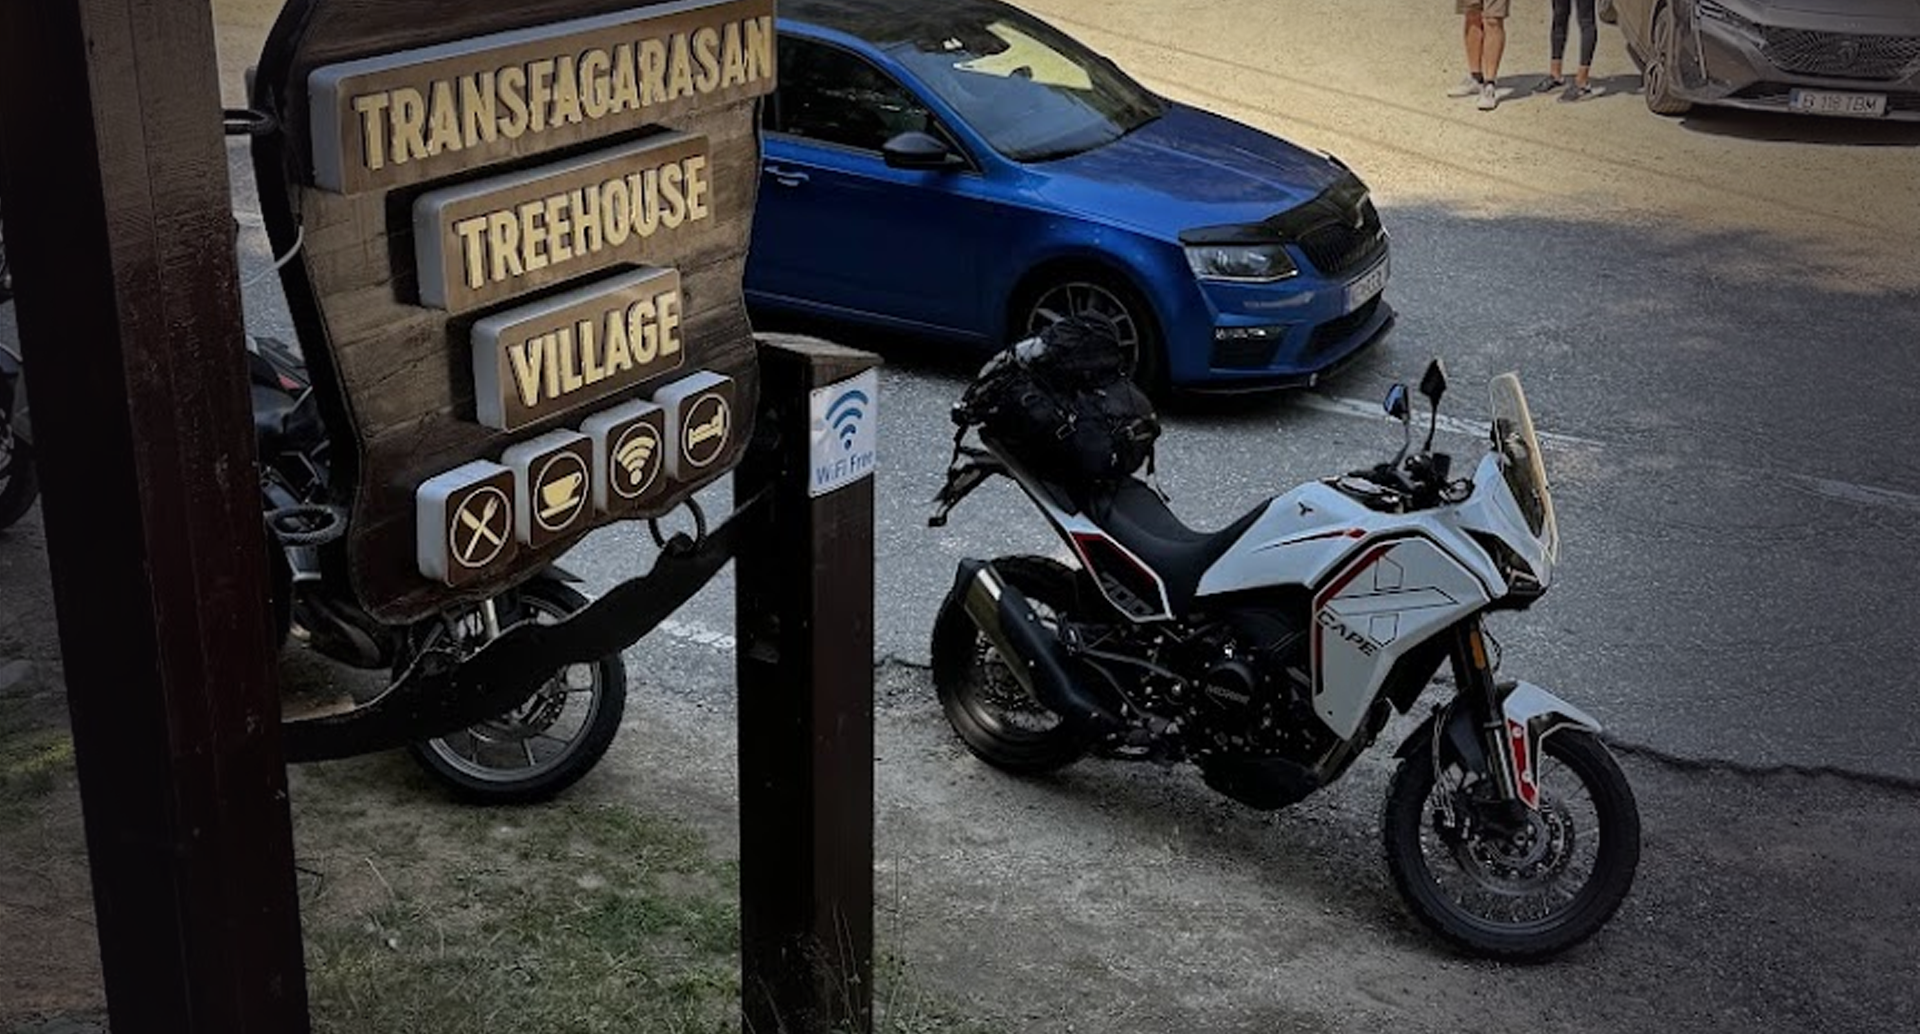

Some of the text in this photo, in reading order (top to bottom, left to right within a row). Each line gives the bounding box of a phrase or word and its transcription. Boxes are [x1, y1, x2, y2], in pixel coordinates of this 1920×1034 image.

[353, 16, 771, 170] TRANSFAGARASAN
[454, 156, 708, 290] TREEHOUSE
[508, 292, 680, 406] VILLAGE
[1317, 610, 1378, 657] CAPE
